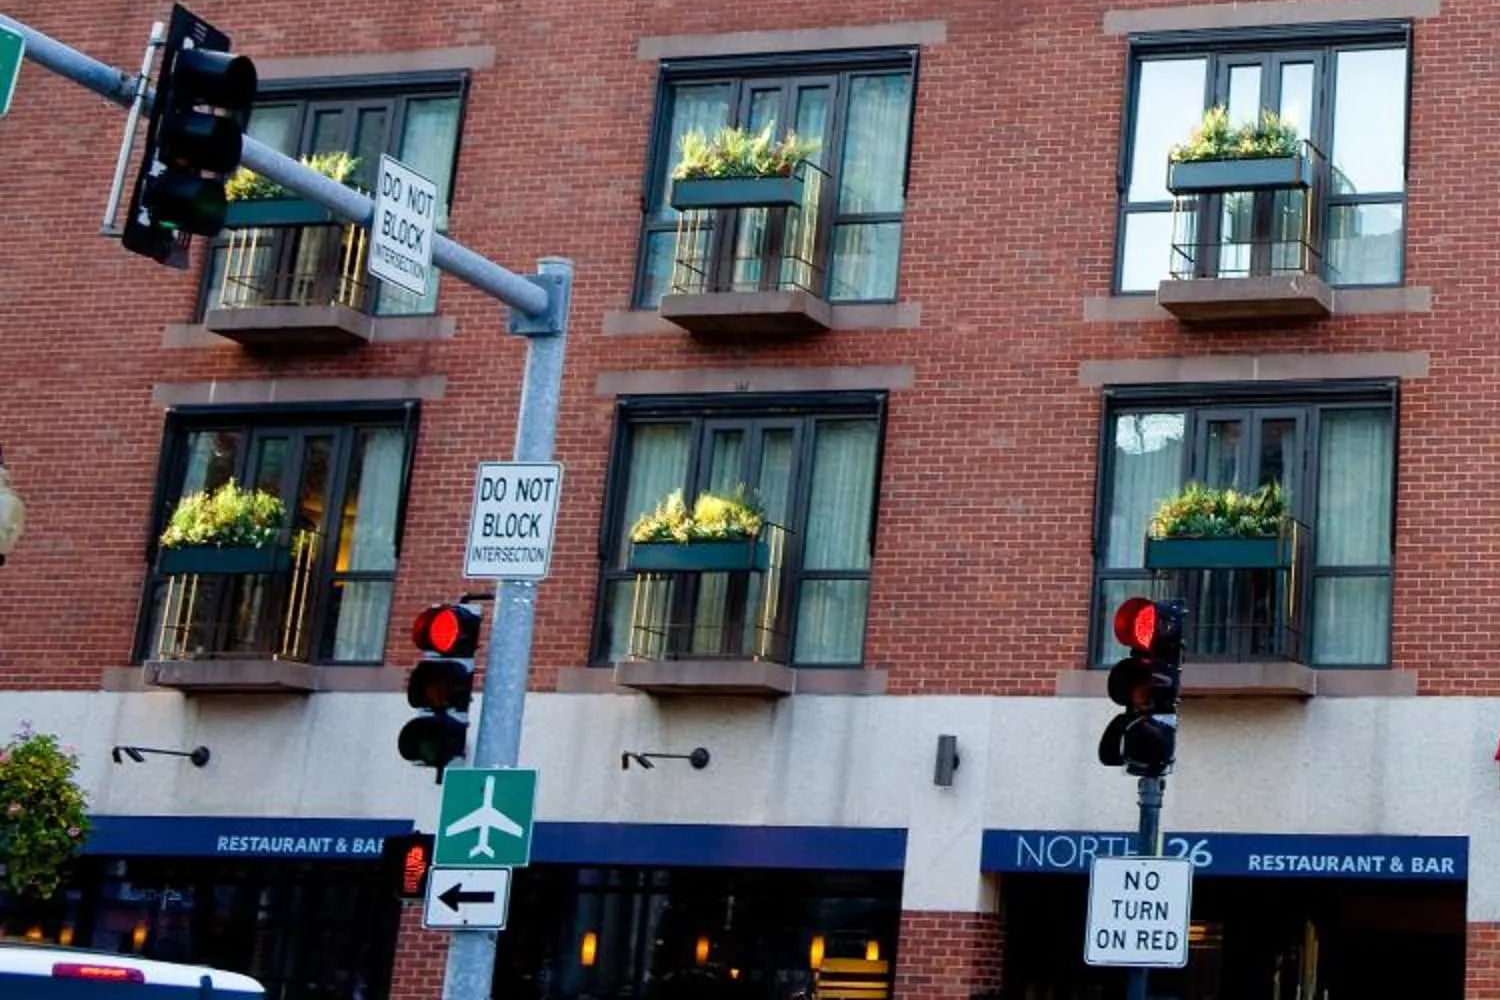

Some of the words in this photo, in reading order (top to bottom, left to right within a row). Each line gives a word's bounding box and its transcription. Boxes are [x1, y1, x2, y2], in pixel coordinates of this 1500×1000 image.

[382, 172, 401, 203] DO
[407, 184, 434, 220] NOT
[382, 210, 425, 255] BLOCK
[375, 242, 425, 280] INTERSECTION
[481, 477, 507, 502] DO
[516, 478, 554, 502] NOT
[482, 513, 543, 538] BLOCK
[472, 546, 545, 563] INTERSECTION
[217, 835, 333, 853] RESTAURANT
[335, 837, 348, 853] &
[1167, 838, 1213, 868] 26
[1248, 854, 1385, 873] RESTAURANT
[1389, 856, 1404, 873] &
[1411, 857, 1455, 874] BAR
[1124, 871, 1160, 891] NO
[1112, 900, 1169, 921] TURN
[1097, 929, 1127, 950] ON
[1136, 930, 1179, 951] RED
